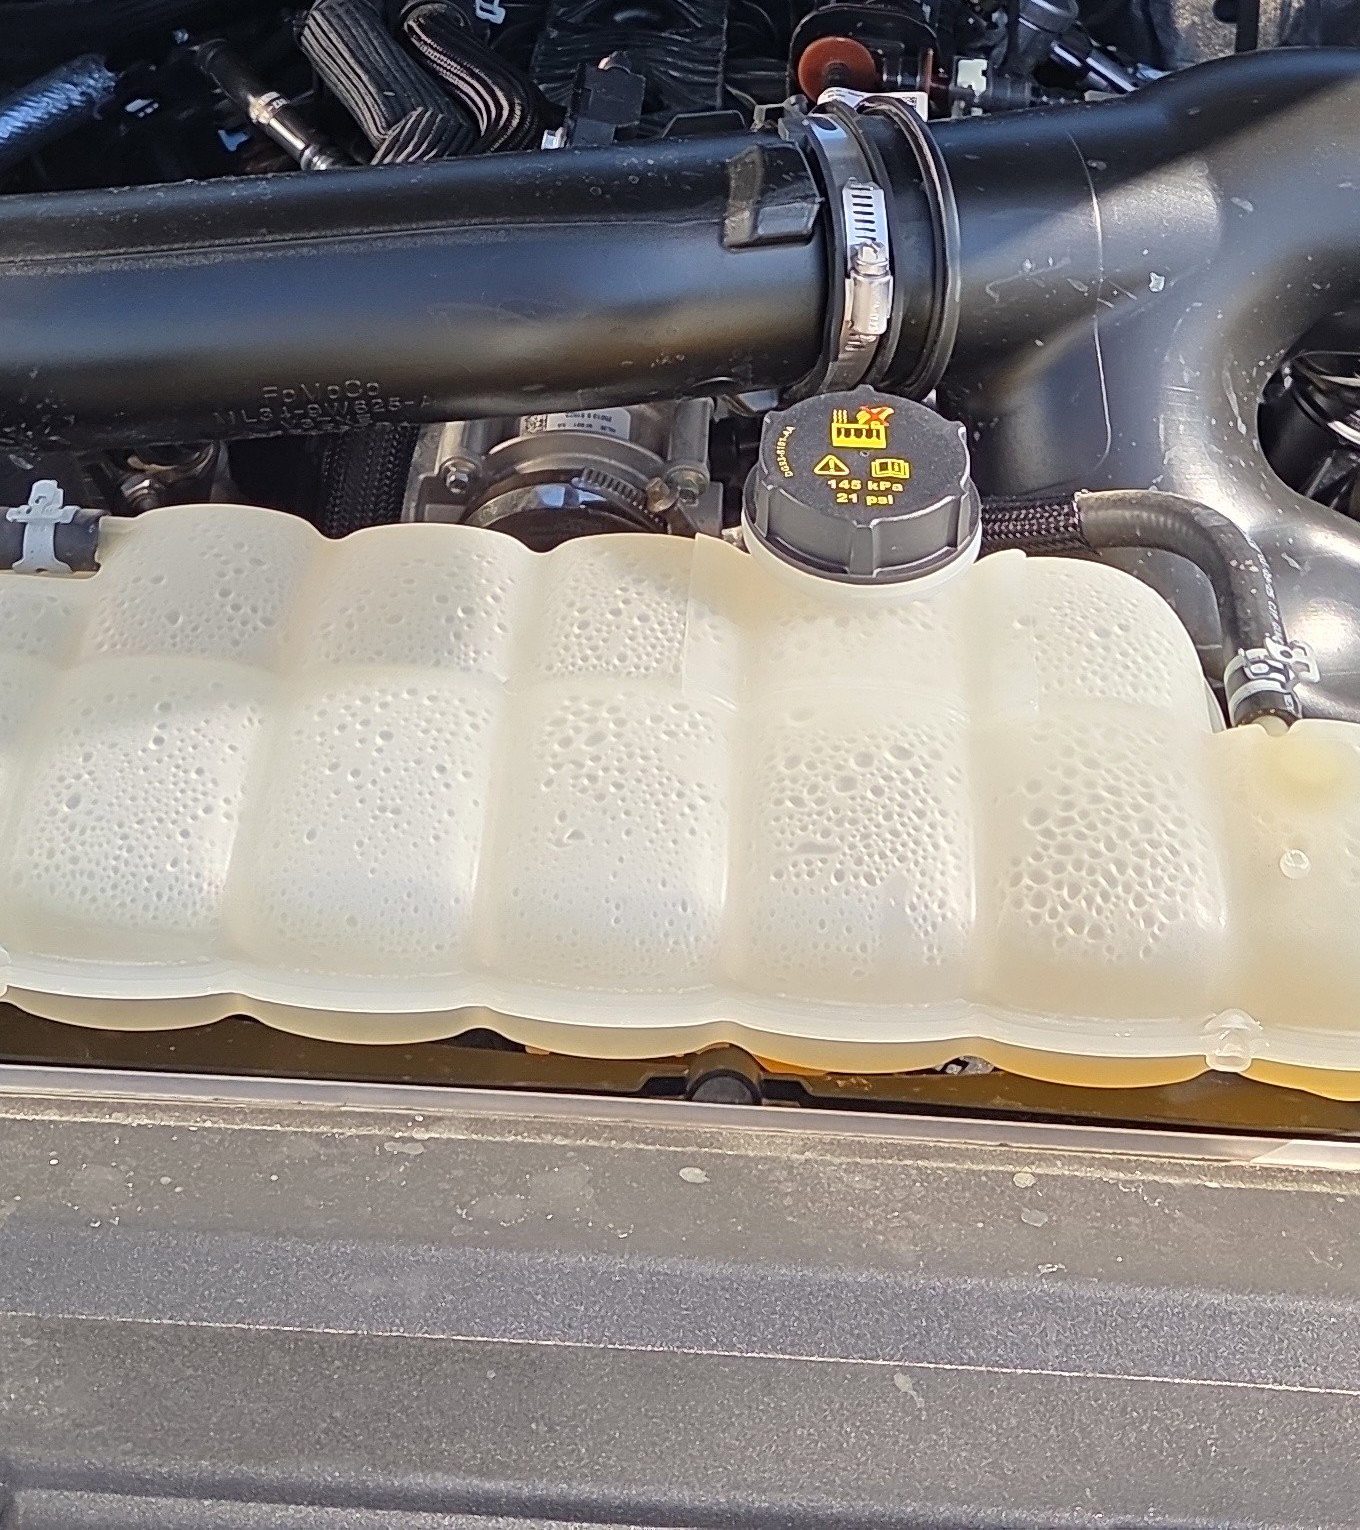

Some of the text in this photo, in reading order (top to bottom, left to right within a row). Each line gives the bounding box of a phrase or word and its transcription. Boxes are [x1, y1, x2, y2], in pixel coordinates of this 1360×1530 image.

[262, 379, 381, 404] FoMoCo
[827, 479, 904, 492] 145 kPa
[836, 492, 894, 507] 21 psi
